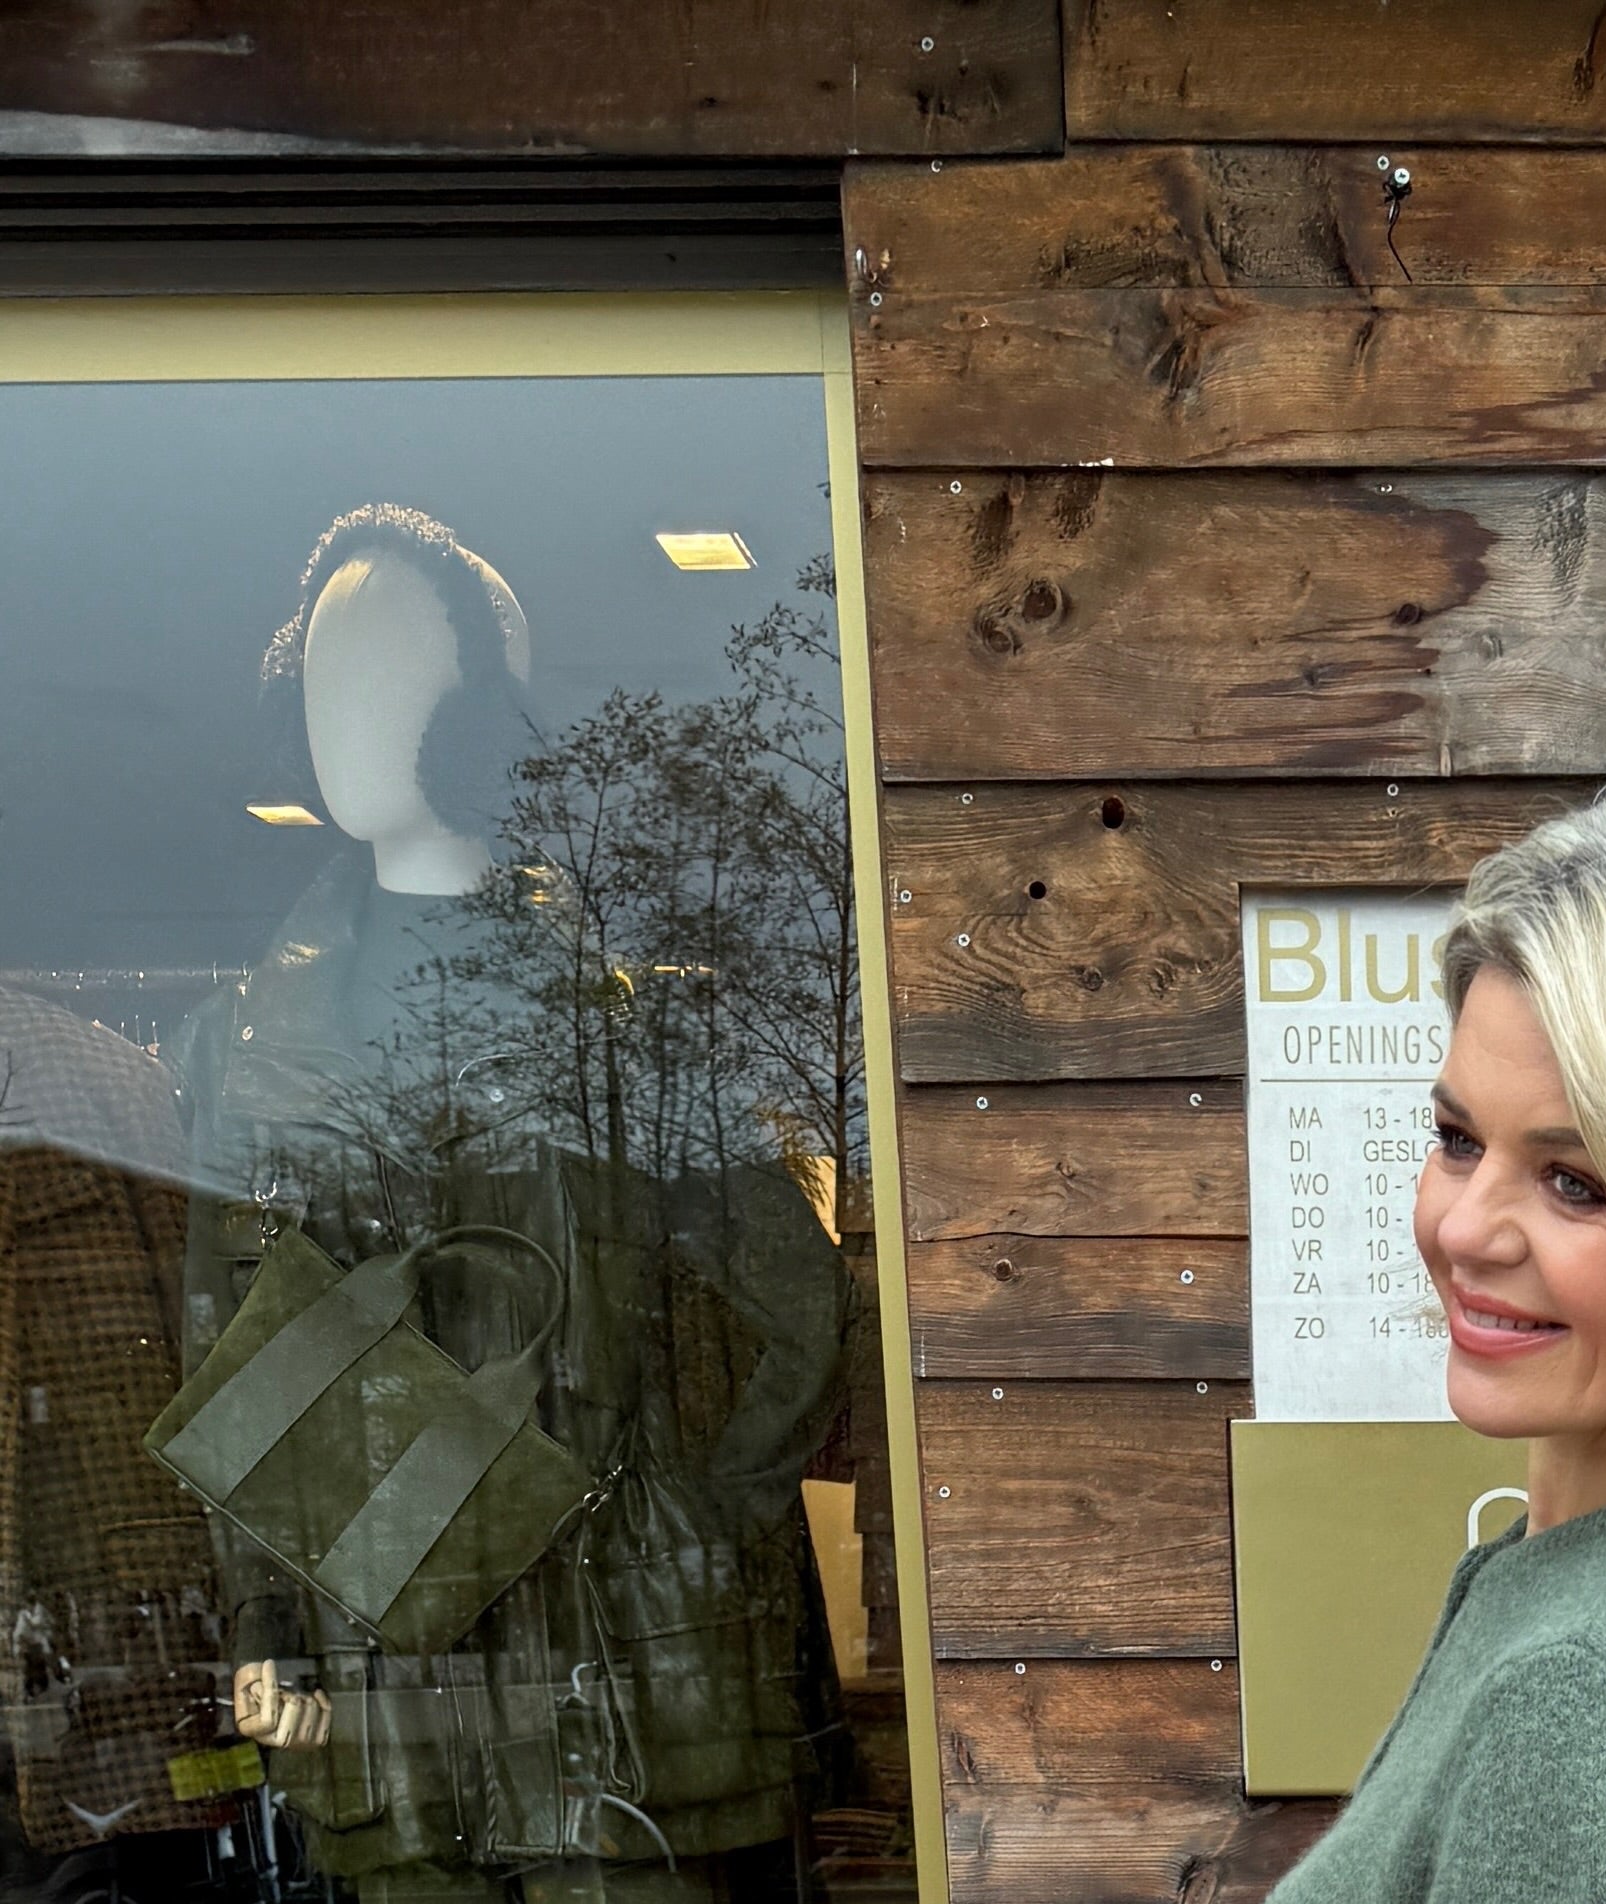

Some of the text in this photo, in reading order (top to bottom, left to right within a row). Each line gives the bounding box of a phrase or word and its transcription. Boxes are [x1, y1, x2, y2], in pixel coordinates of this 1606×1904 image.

[1289, 1106, 1323, 1129] MA
[1363, 1107, 1387, 1130] 13
[1290, 1140, 1311, 1162] DI
[1290, 1173, 1329, 1196] WO
[1365, 1173, 1388, 1196] 10
[1292, 1206, 1325, 1229] DO
[1365, 1206, 1389, 1229] 10
[1291, 1239, 1323, 1261] VR
[1366, 1239, 1389, 1262] 10
[1293, 1271, 1322, 1294] ZA
[1367, 1272, 1390, 1294] 10
[1294, 1317, 1325, 1339] ZO
[1369, 1316, 1392, 1338] 14
